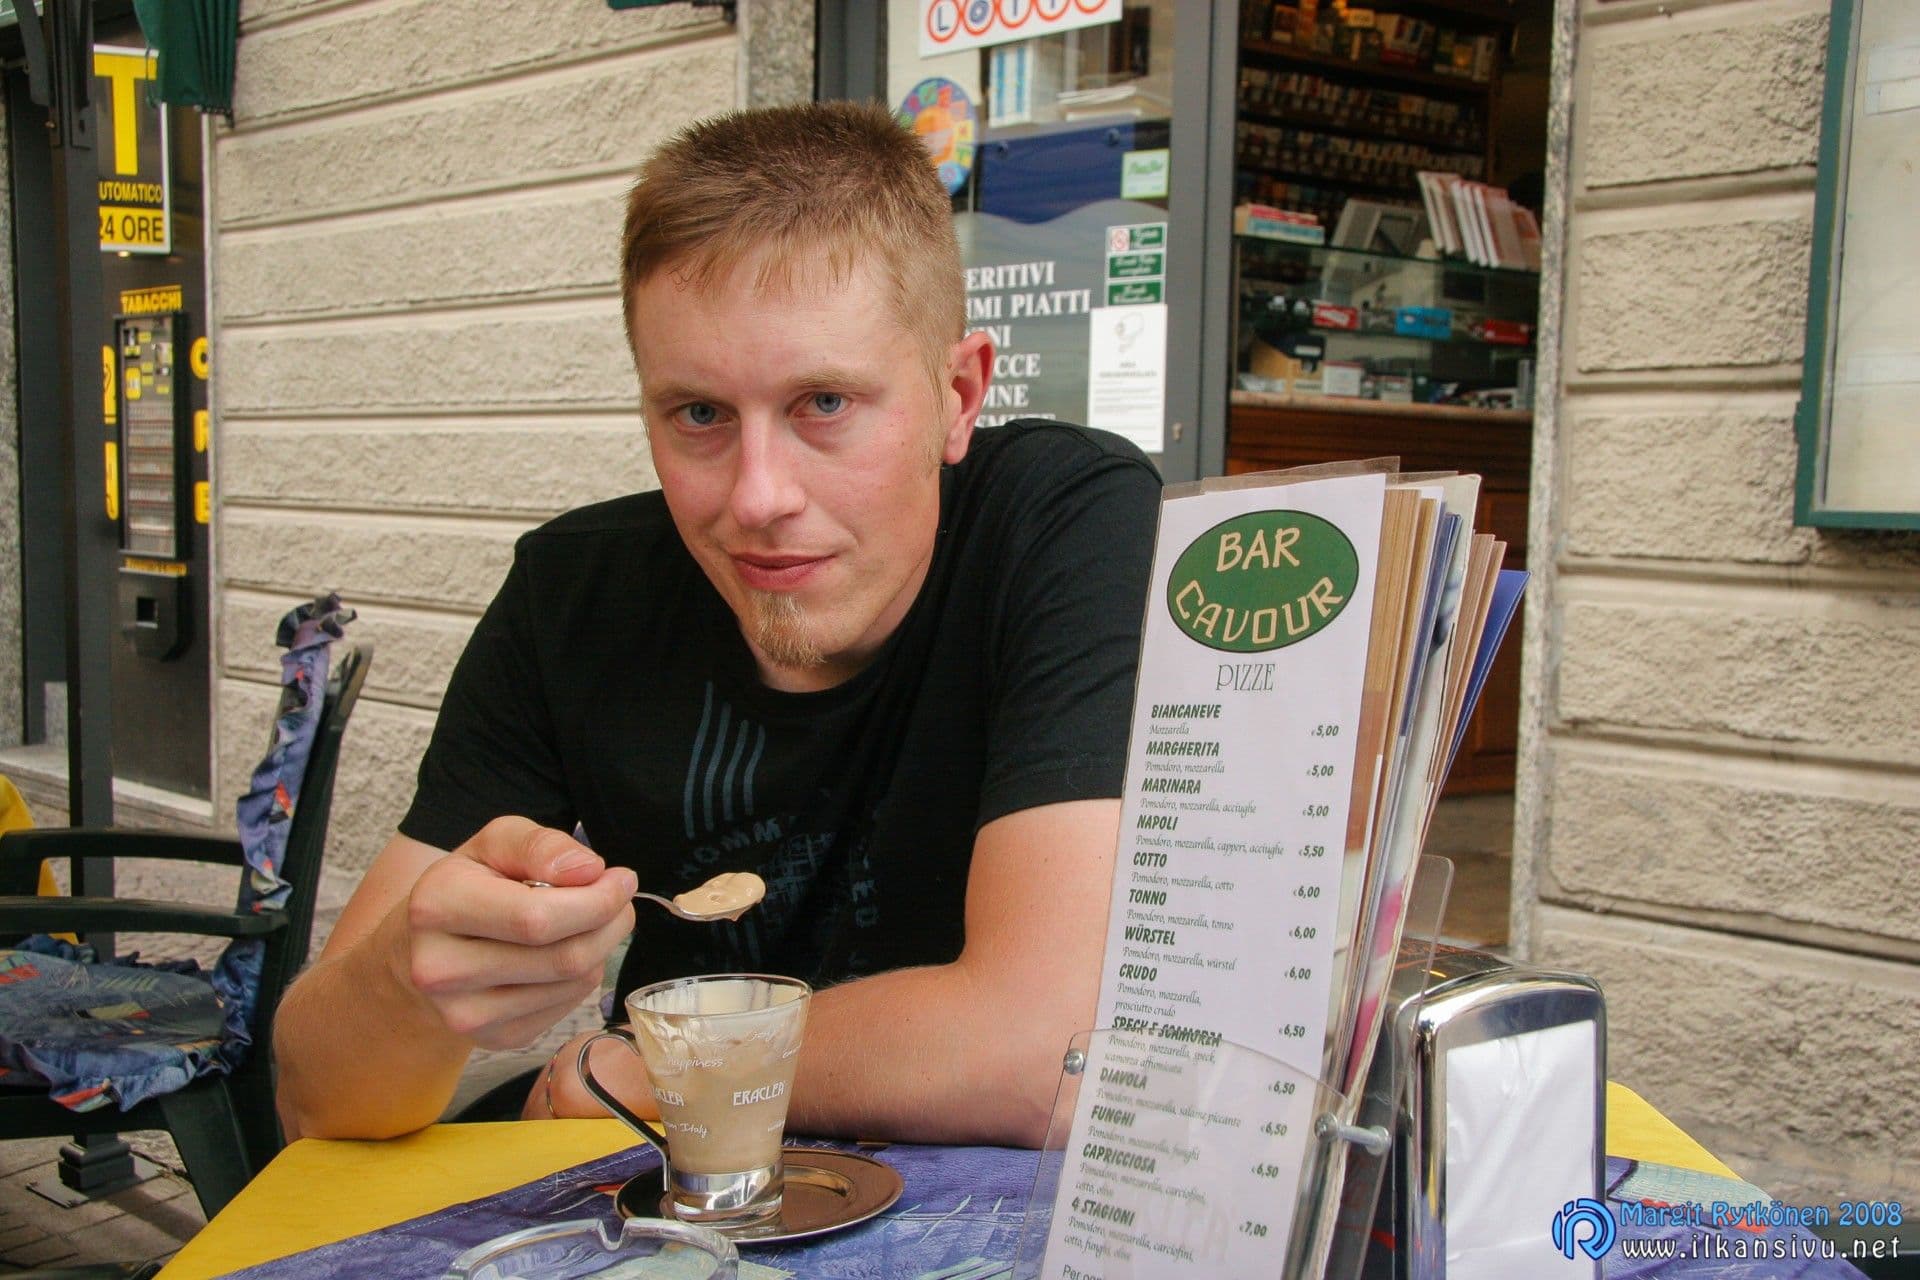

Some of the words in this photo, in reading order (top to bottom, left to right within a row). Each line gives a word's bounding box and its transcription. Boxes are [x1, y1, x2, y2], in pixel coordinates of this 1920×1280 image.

[99, 182, 163, 204] UTOMATICO
[122, 215, 164, 243] ORE
[966, 261, 1055, 290] ERITIVI
[120, 291, 183, 315] TABACCHI
[967, 295, 1003, 320] IMI
[1010, 288, 1091, 318] PIATTI
[1216, 527, 1300, 572] BAR
[1175, 576, 1343, 644] CAVOUR
[1215, 663, 1276, 691] PIZZE
[1151, 704, 1222, 719] BIANCANEVE
[1149, 722, 1189, 736] Mozzarella
[1146, 741, 1219, 757] MARGHERITA
[1144, 760, 1182, 774] Pomodoro,
[1184, 762, 1225, 774] mozzarella
[1141, 778, 1201, 795] MARINARA
[1140, 797, 1177, 810] Pomodoro,
[1179, 799, 1220, 813] mozzarella,
[1222, 801, 1256, 818] acciughe
[1137, 814, 1178, 831] NAPOLI
[1135, 834, 1172, 849] Pomodoro,
[1175, 837, 1215, 852] mozzarella,
[1250, 843, 1284, 859] acciughe
[1133, 851, 1167, 868] COTTO
[1131, 871, 1169, 886] Pomodoro,
[1171, 875, 1213, 890] mozzarella,
[1215, 880, 1235, 891] cotto
[1129, 888, 1167, 906] TONNO
[1126, 909, 1165, 924] Pomodoro,
[1167, 913, 1209, 929] mozzarella,
[1211, 919, 1234, 931] tonno
[1124, 924, 1176, 946] WÜRSTEL
[1122, 946, 1161, 962] Pomodoro,
[1162, 951, 1204, 967] mozzarella,
[1119, 964, 1158, 982] CRUDO
[1116, 983, 1156, 999] Pomodoro,
[1158, 990, 1201, 1006] mozzarella,
[1114, 999, 1153, 1015] prosciutto
[1154, 1005, 1176, 1018] crudo
[1112, 1015, 1149, 1035] SPECK
[1149, 1022, 1158, 1036] E
[1108, 1034, 1146, 1050] Pomodoro,
[1100, 1066, 1147, 1090] DIAVOLA
[733, 1080, 785, 1107] ERACLEA
[1091, 1104, 1136, 1127] FUNGHI
[1205, 1111, 1242, 1128] piccante
[1083, 1143, 1156, 1174] CAPRICCIOSA
[1071, 1196, 1080, 1212] 4
[1081, 1199, 1136, 1227] STAGIONI
